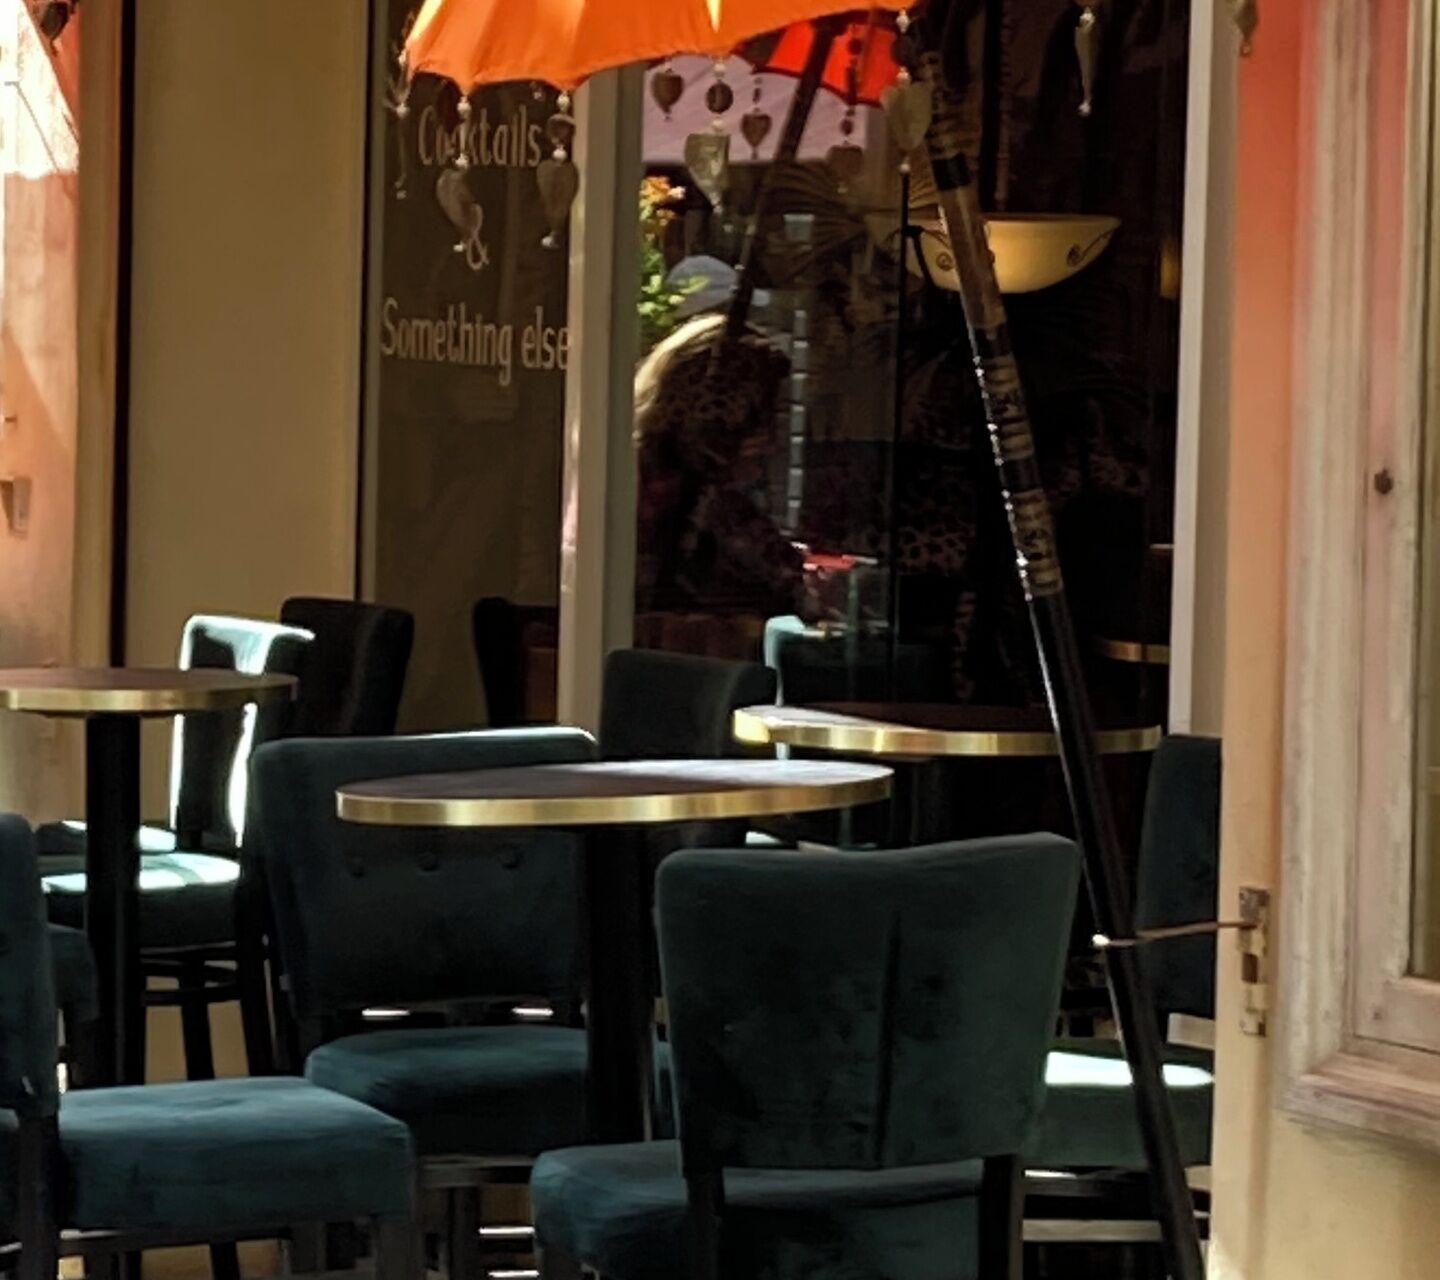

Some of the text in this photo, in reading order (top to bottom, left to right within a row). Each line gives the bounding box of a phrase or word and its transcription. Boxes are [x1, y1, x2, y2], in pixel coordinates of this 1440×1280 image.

[418, 104, 542, 167] Cocktails
[464, 203, 490, 270] &
[381, 297, 570, 386] Something else
